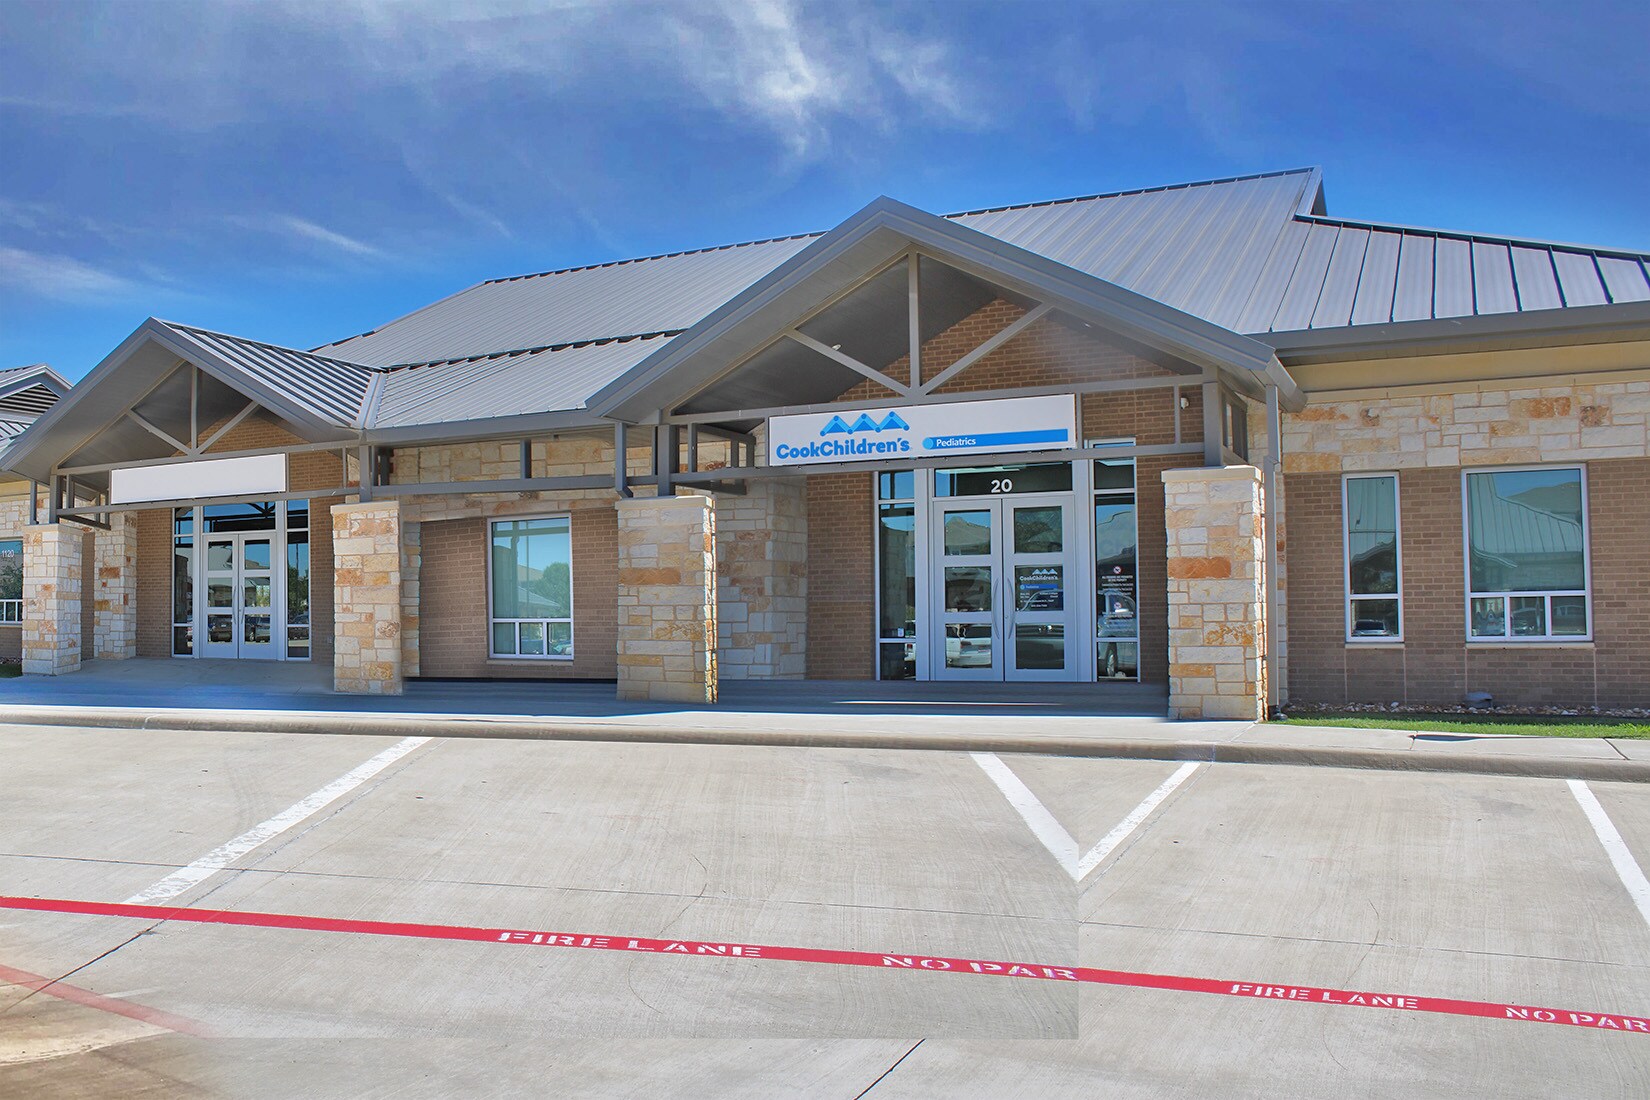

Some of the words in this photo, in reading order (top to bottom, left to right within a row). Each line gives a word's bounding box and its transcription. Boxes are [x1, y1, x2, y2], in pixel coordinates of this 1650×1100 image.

[776, 438, 910, 460] CookChildren's
[936, 437, 976, 448] Pediatrics
[991, 478, 1013, 493] 20
[498, 932, 610, 948] FIRE
[627, 940, 761, 957] LANE
[882, 956, 951, 969] NO
[969, 962, 1078, 981] PAR
[1230, 984, 1311, 1000] FIRE
[1322, 992, 1418, 1009] LANE
[1505, 1006, 1556, 1021] NO
[1569, 1013, 1649, 1032] PAR
